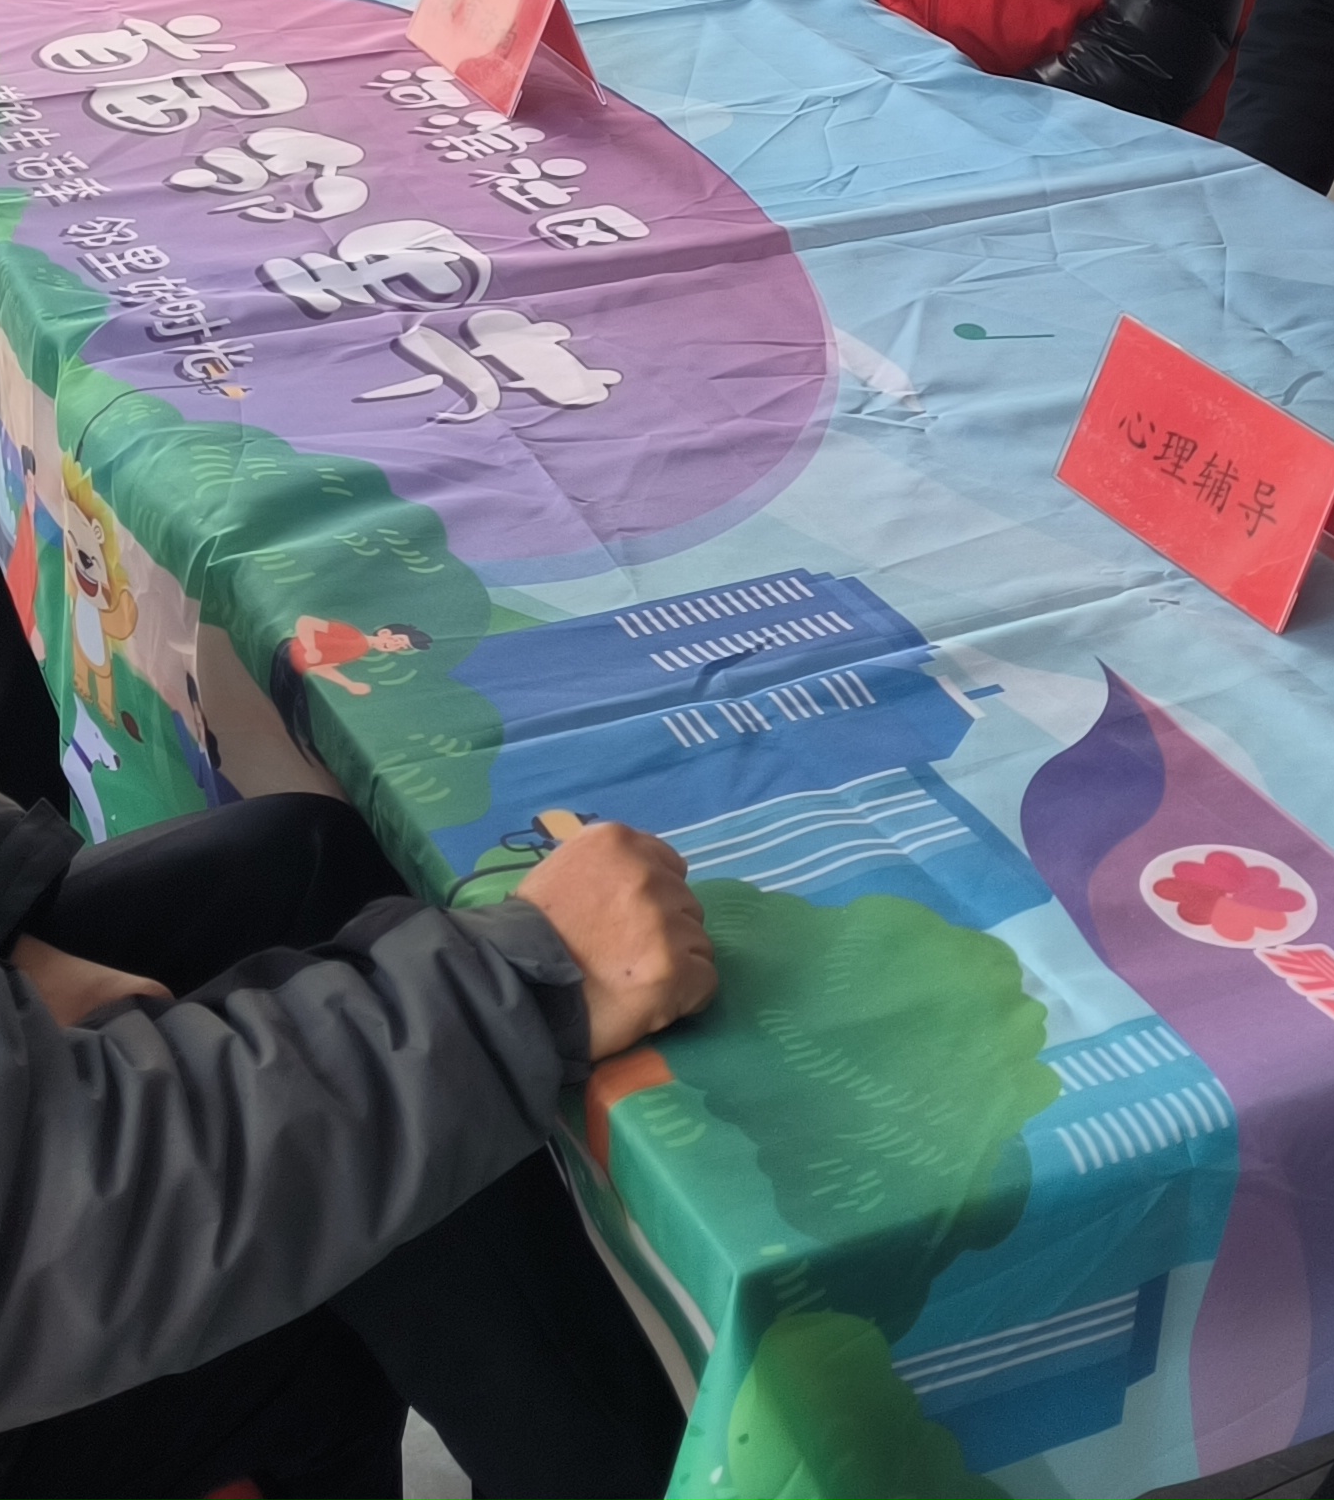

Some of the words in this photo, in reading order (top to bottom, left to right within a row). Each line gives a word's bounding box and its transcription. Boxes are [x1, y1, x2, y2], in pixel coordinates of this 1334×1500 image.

[35, 13, 625, 426] 首届邻里节
[367, 65, 651, 250] 河滨社区
[64, 215, 255, 381] 邻里好时光
[1117, 407, 1280, 542] 心理辅导
